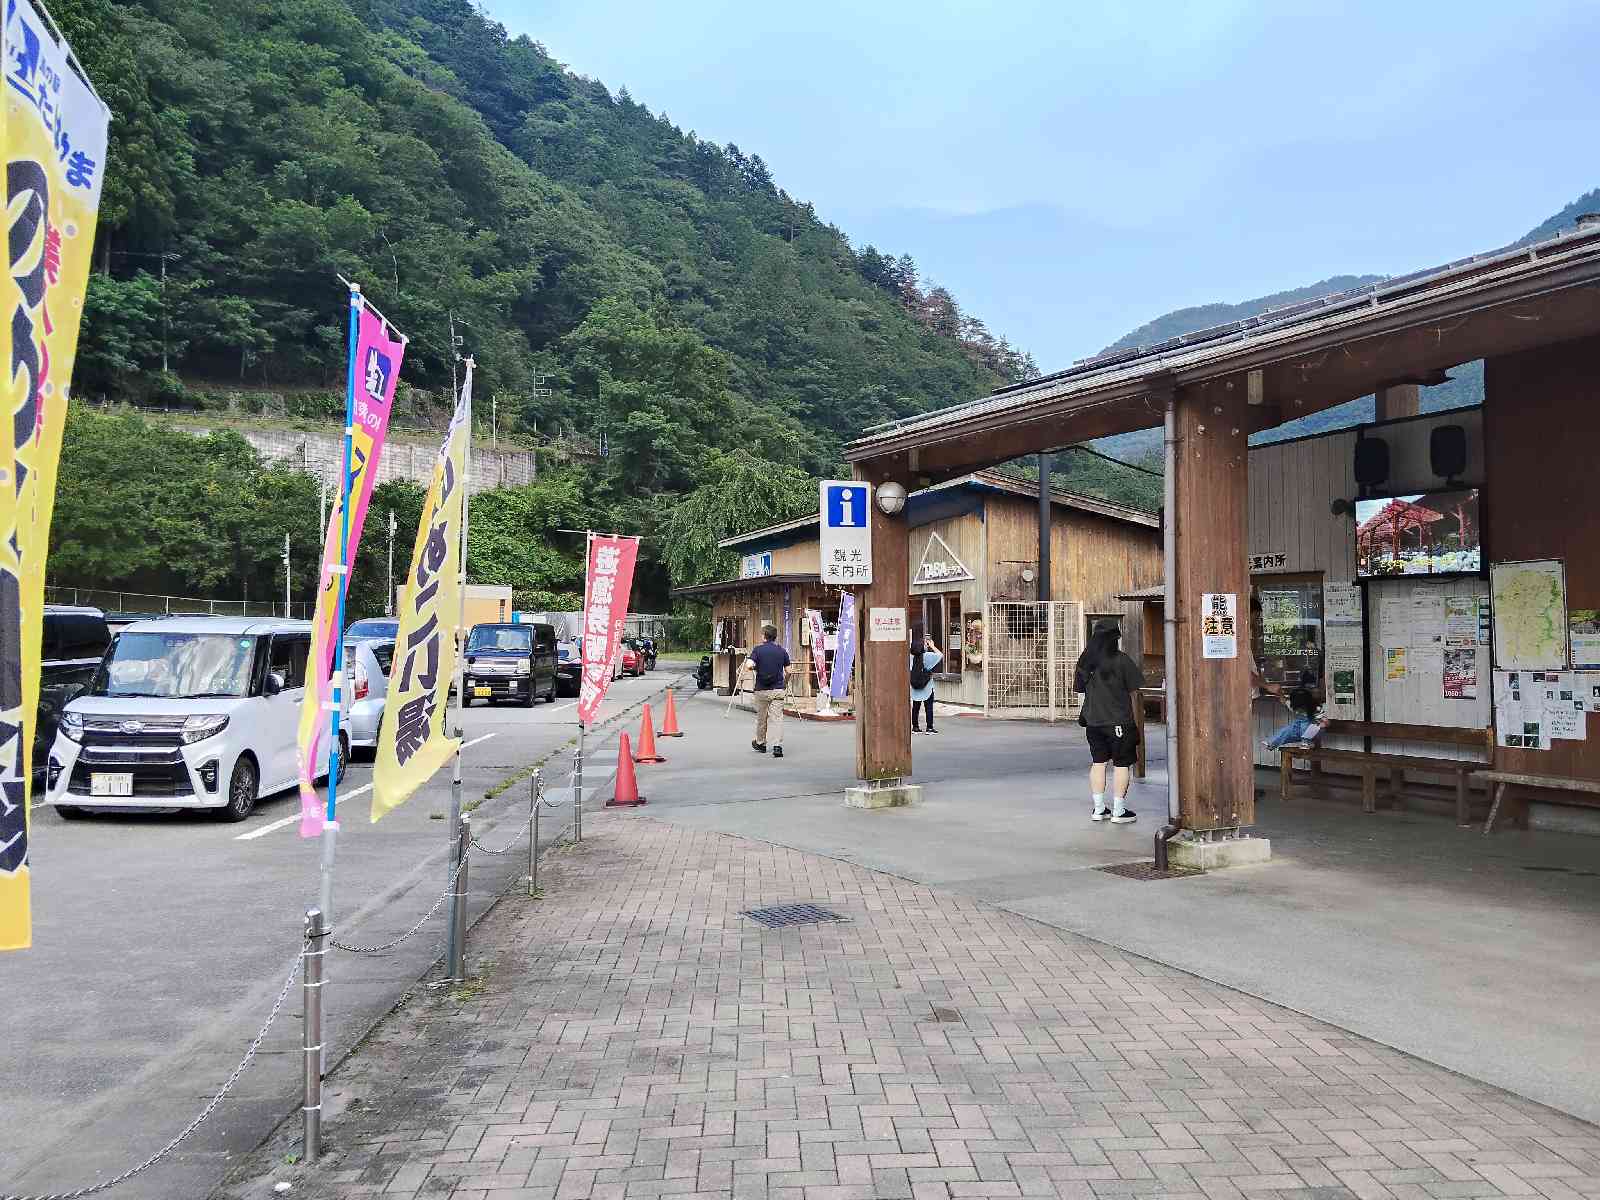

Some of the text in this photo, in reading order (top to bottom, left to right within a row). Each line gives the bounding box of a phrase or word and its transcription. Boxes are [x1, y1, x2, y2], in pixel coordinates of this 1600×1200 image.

[833, 548, 862, 562] 観光
[827, 564, 868, 578] 案内所
[1203, 616, 1236, 637] 注意
